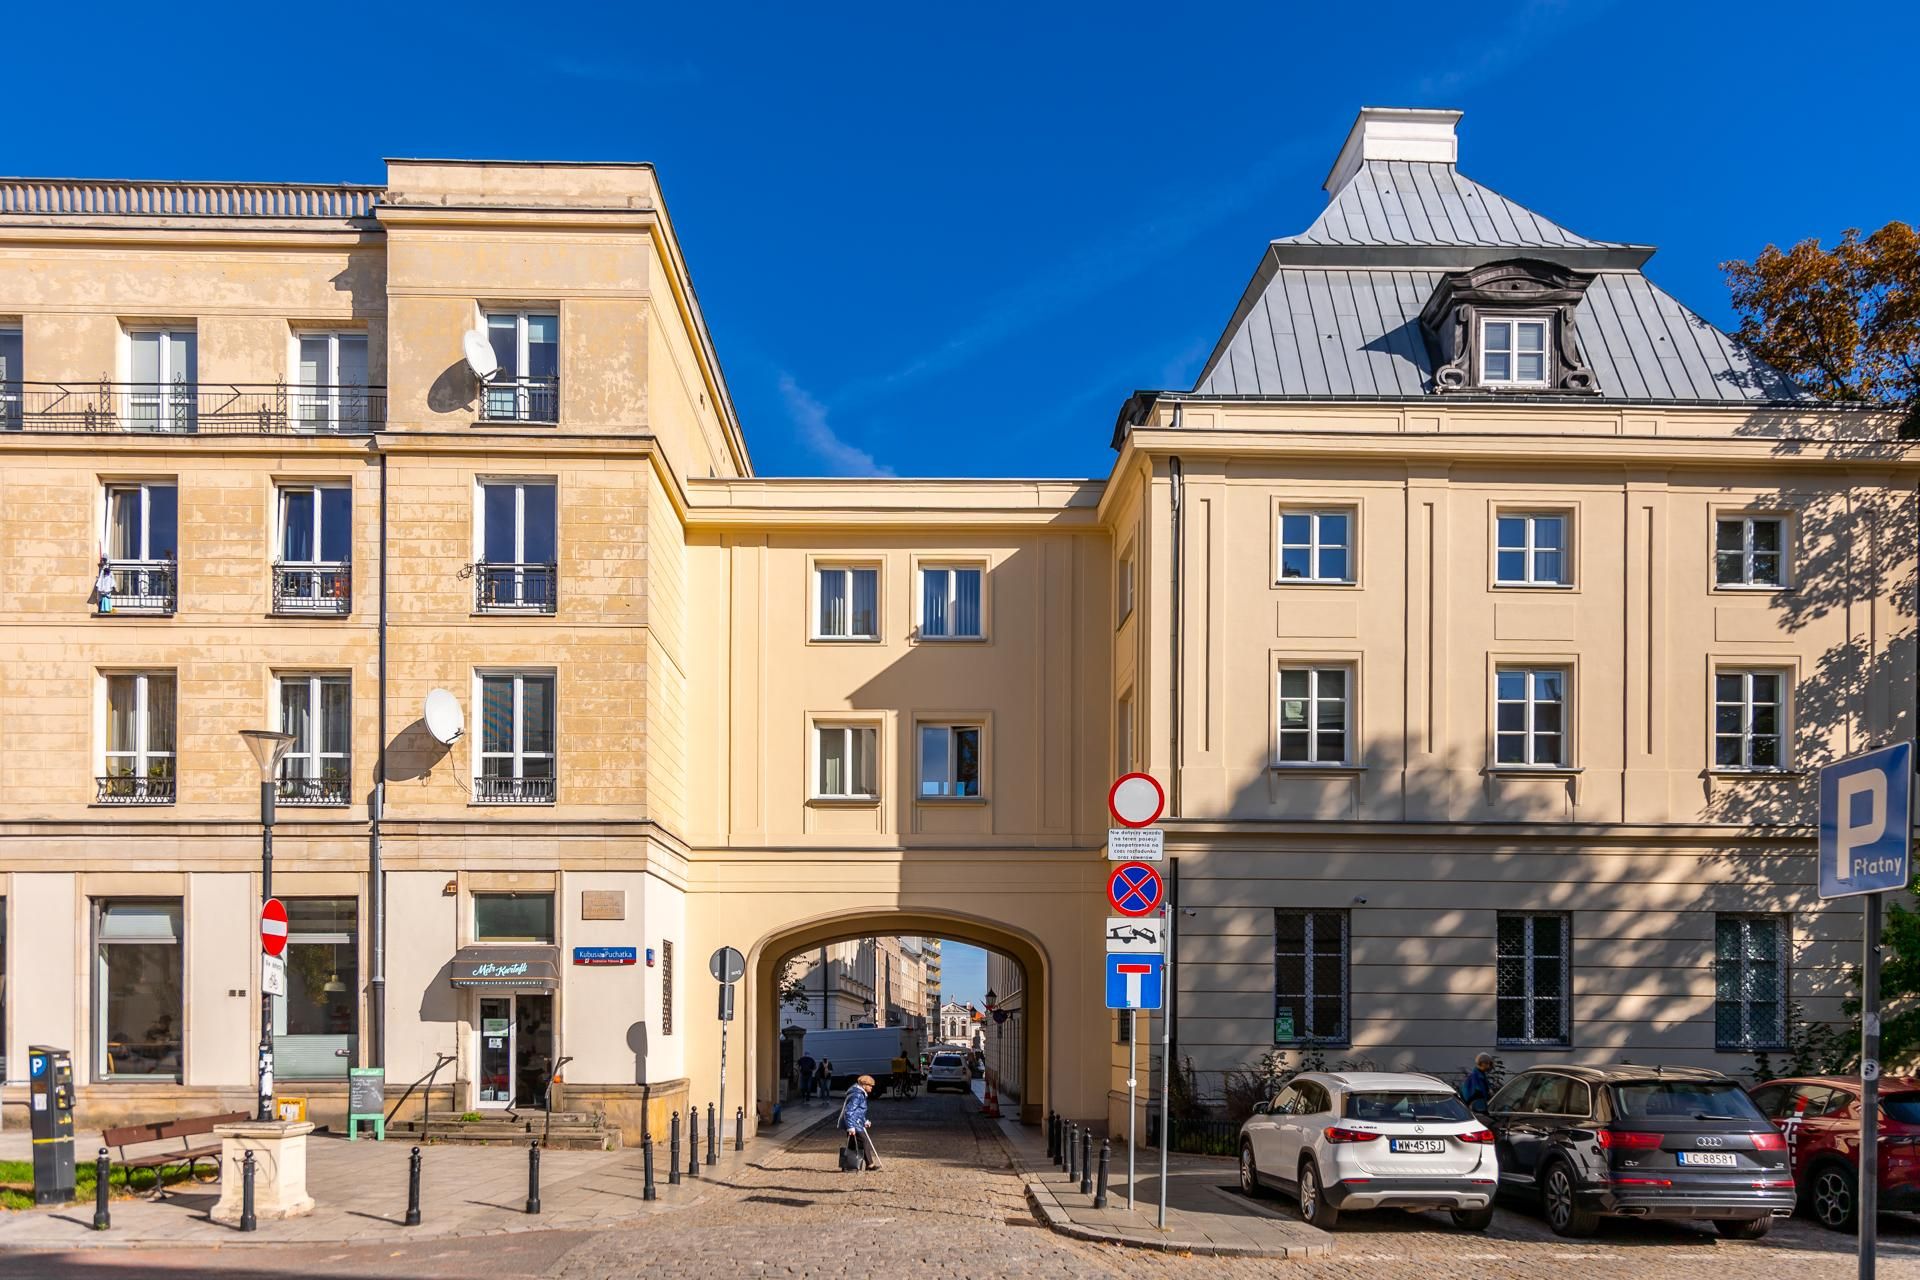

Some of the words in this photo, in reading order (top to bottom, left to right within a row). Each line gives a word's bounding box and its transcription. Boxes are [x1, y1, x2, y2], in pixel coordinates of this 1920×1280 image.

[1836, 767, 1888, 880] P
[1853, 856, 1903, 876] Płatny
[32, 1058, 43, 1074] P
[1398, 1141, 1411, 1150] WW
[1414, 1140, 1441, 1150] 451SJ
[1685, 1153, 1700, 1164] LC
[1702, 1154, 1734, 1165] 88581
